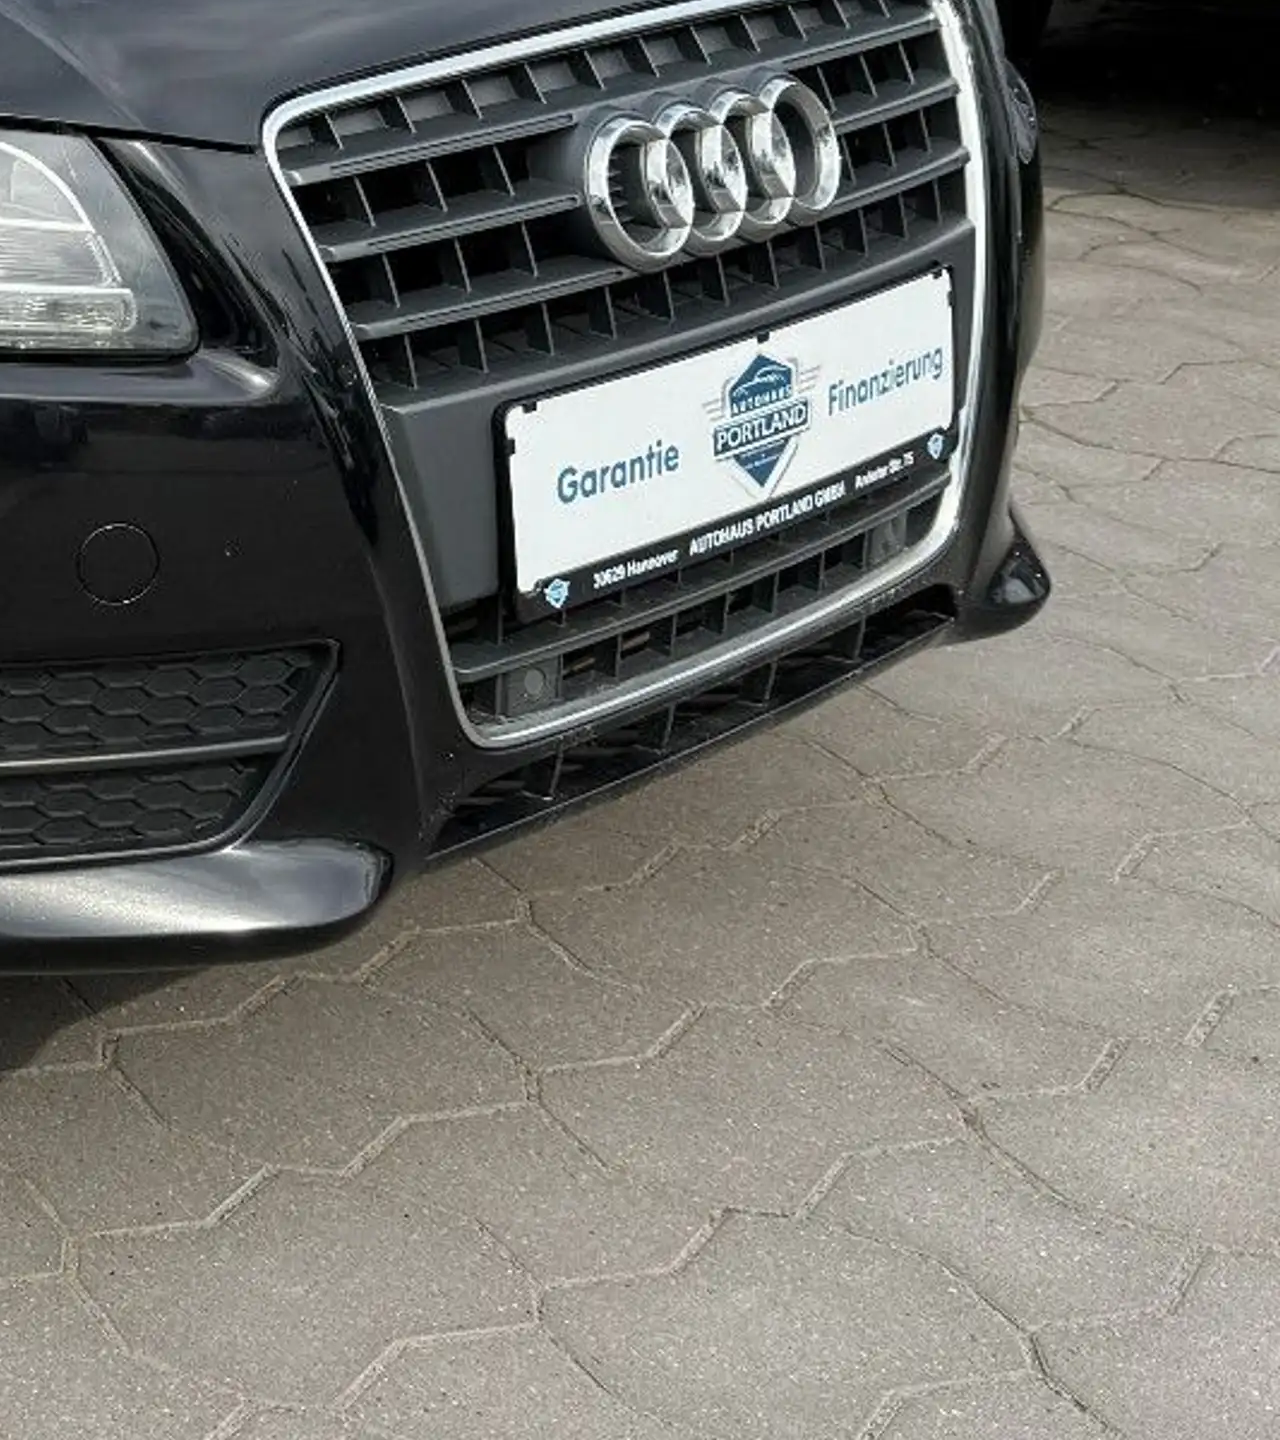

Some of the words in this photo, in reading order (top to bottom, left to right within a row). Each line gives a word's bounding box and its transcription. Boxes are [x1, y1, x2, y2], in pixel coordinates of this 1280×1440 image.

[828, 347, 944, 417] Finanzierung
[716, 404, 807, 452] PORTLAND
[557, 439, 680, 504] Garantie
[627, 549, 679, 577] Hannover
[689, 517, 754, 557] AUTOHAUS
[756, 493, 814, 532] PORTLAND
